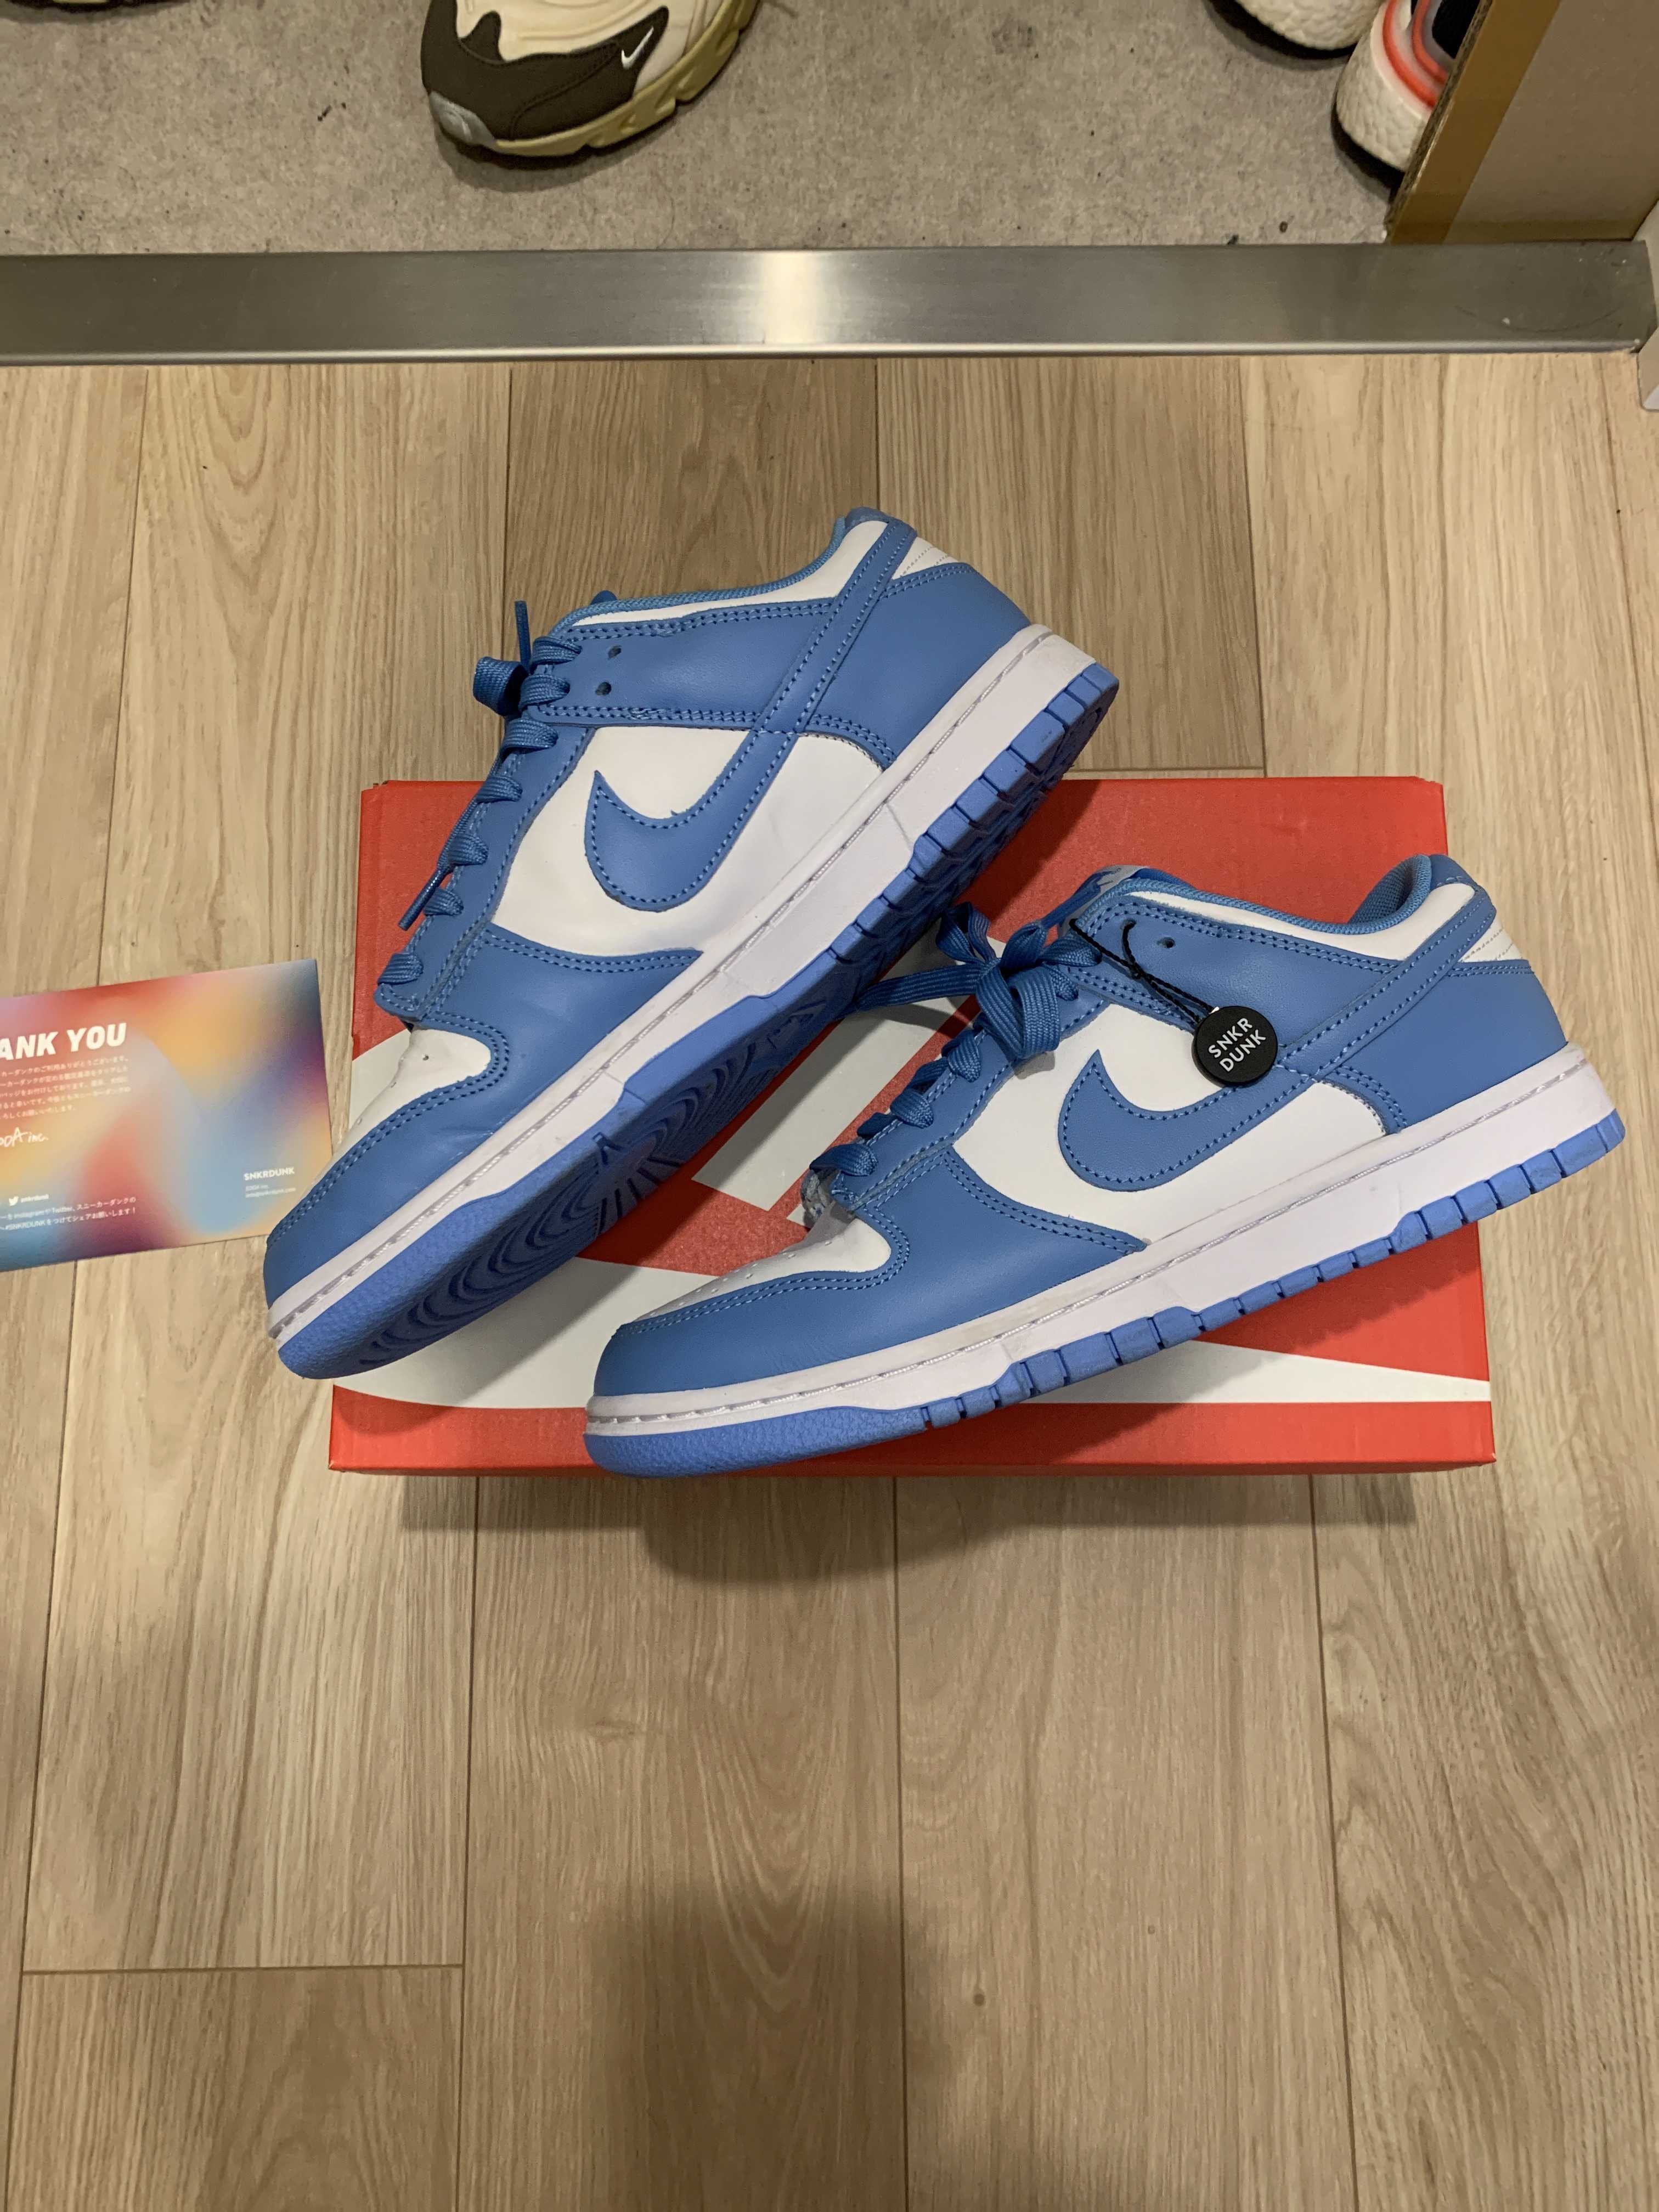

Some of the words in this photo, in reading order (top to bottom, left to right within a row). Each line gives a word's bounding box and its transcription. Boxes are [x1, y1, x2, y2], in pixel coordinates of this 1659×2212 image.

[66, 1023, 127, 1052] YOU
[1208, 1018, 1252, 1058] SNKR
[1219, 1029, 1266, 1071] DUNK
[244, 1166, 295, 1181] SNKRDUNK
